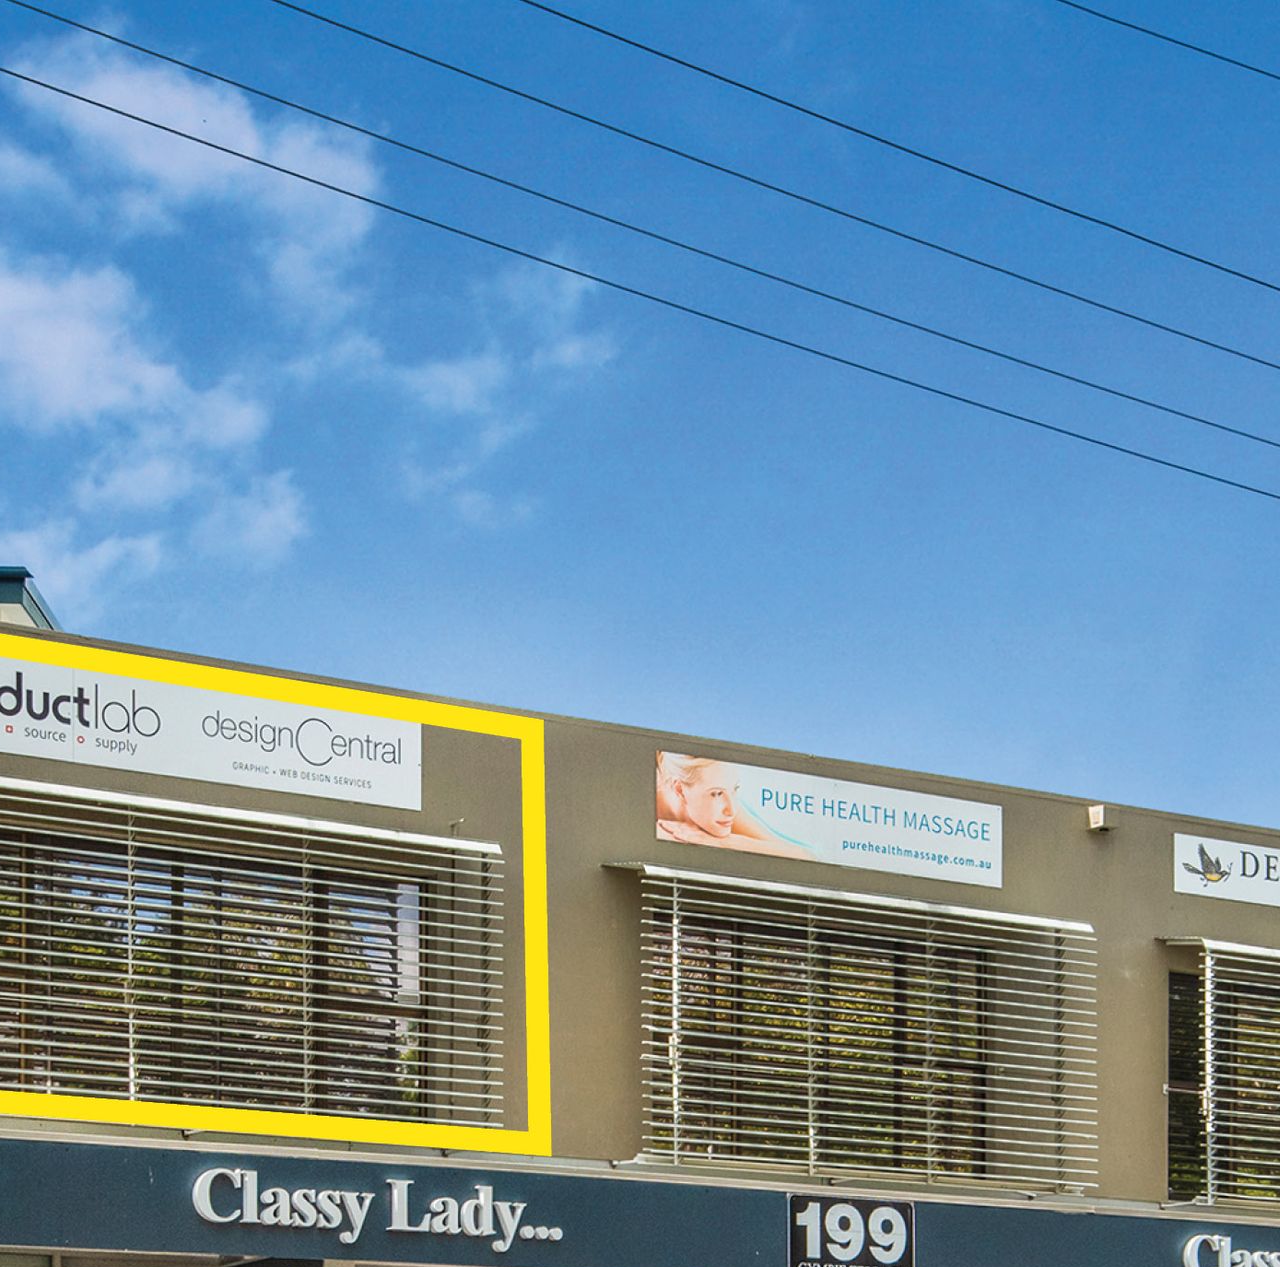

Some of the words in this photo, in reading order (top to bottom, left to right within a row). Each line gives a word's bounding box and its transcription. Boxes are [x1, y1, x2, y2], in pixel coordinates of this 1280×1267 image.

[24, 726, 67, 743] source
[95, 735, 138, 755] supply
[201, 709, 402, 767] designCentral
[232, 761, 270, 775] GRAPHIC
[279, 768, 298, 779] WEB
[301, 772, 331, 784] DESIGN
[333, 775, 373, 789] SERVICES
[761, 788, 815, 815] PURE
[821, 797, 897, 828] HEALTH
[903, 811, 992, 842] MASSAGE
[842, 839, 993, 870] purehealthmassage.com.au
[191, 1167, 376, 1245] Classy
[385, 1178, 564, 1254] Lady...
[795, 1202, 908, 1264] 199
